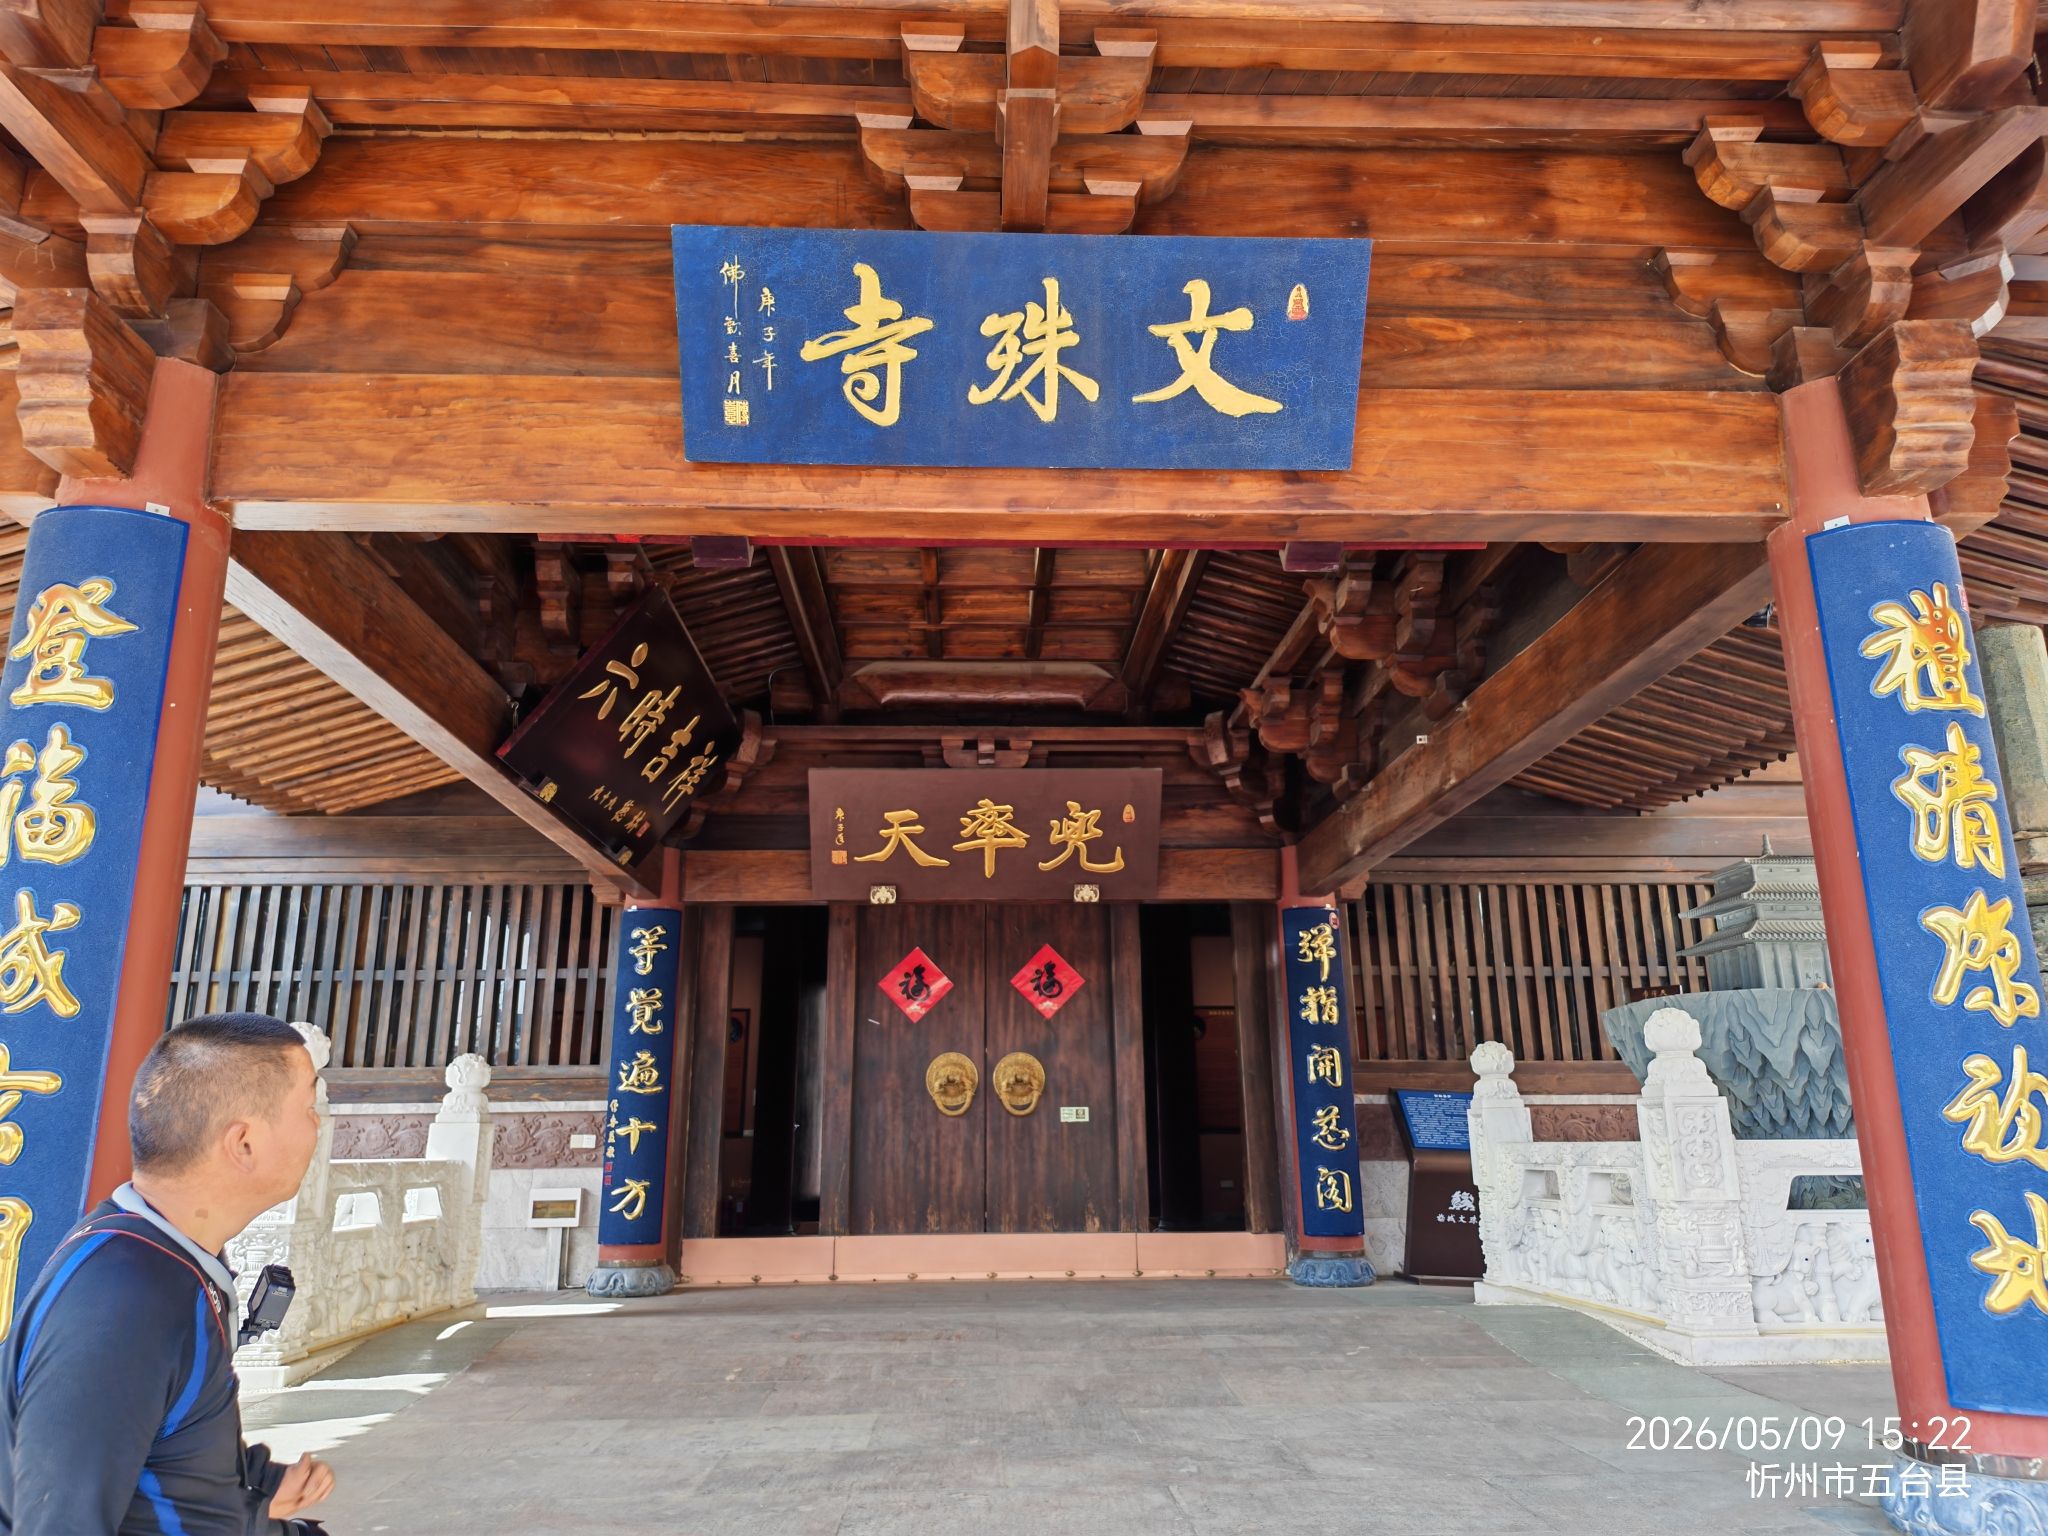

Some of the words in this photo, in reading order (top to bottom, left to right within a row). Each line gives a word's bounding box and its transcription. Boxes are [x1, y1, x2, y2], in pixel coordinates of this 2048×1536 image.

[800, 262, 1284, 427] 文殊寺
[853, 798, 1125, 879] 兜率天
